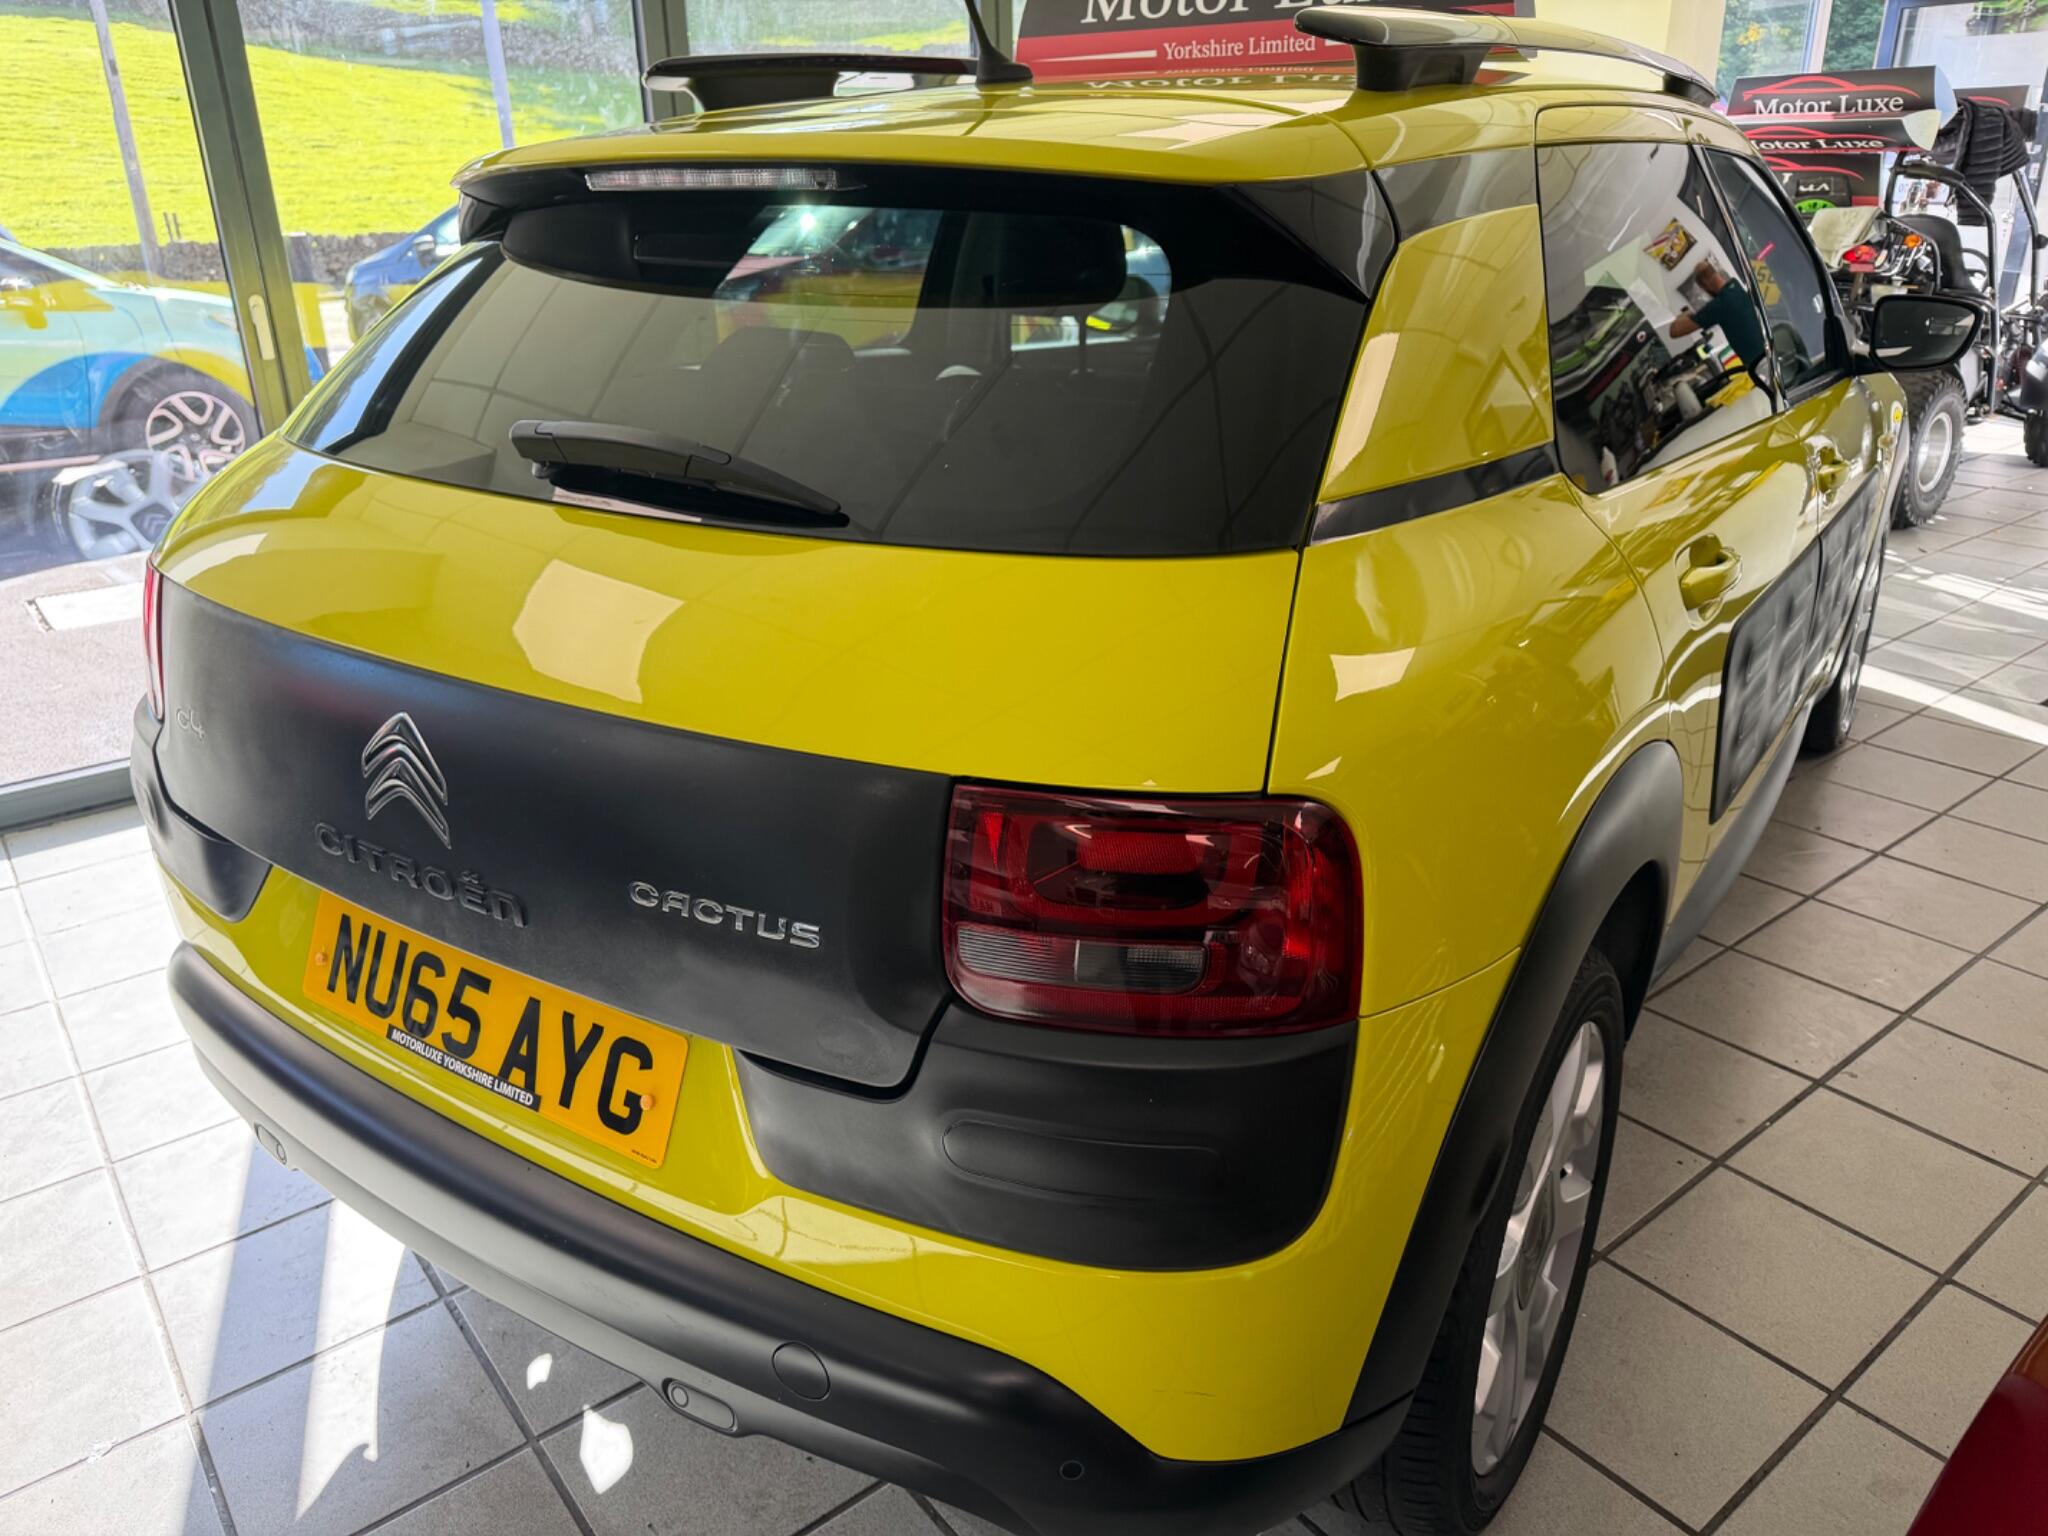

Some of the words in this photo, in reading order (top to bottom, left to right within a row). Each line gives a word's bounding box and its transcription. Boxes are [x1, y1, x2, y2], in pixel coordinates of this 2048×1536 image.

[1163, 39, 1244, 60] Yorkshire
[1247, 35, 1316, 56] Limited
[1753, 99, 1831, 115] Motor
[1839, 95, 1904, 114] Luxe
[1816, 138, 1885, 149] Luxe
[629, 881, 821, 949] CACTUS
[326, 914, 493, 1060] NU65
[498, 997, 654, 1136] AYG
[391, 1028, 443, 1064] MOTORLUXE
[442, 1055, 493, 1090] YORKSHIRE
[494, 1078, 534, 1107] LIMITED
